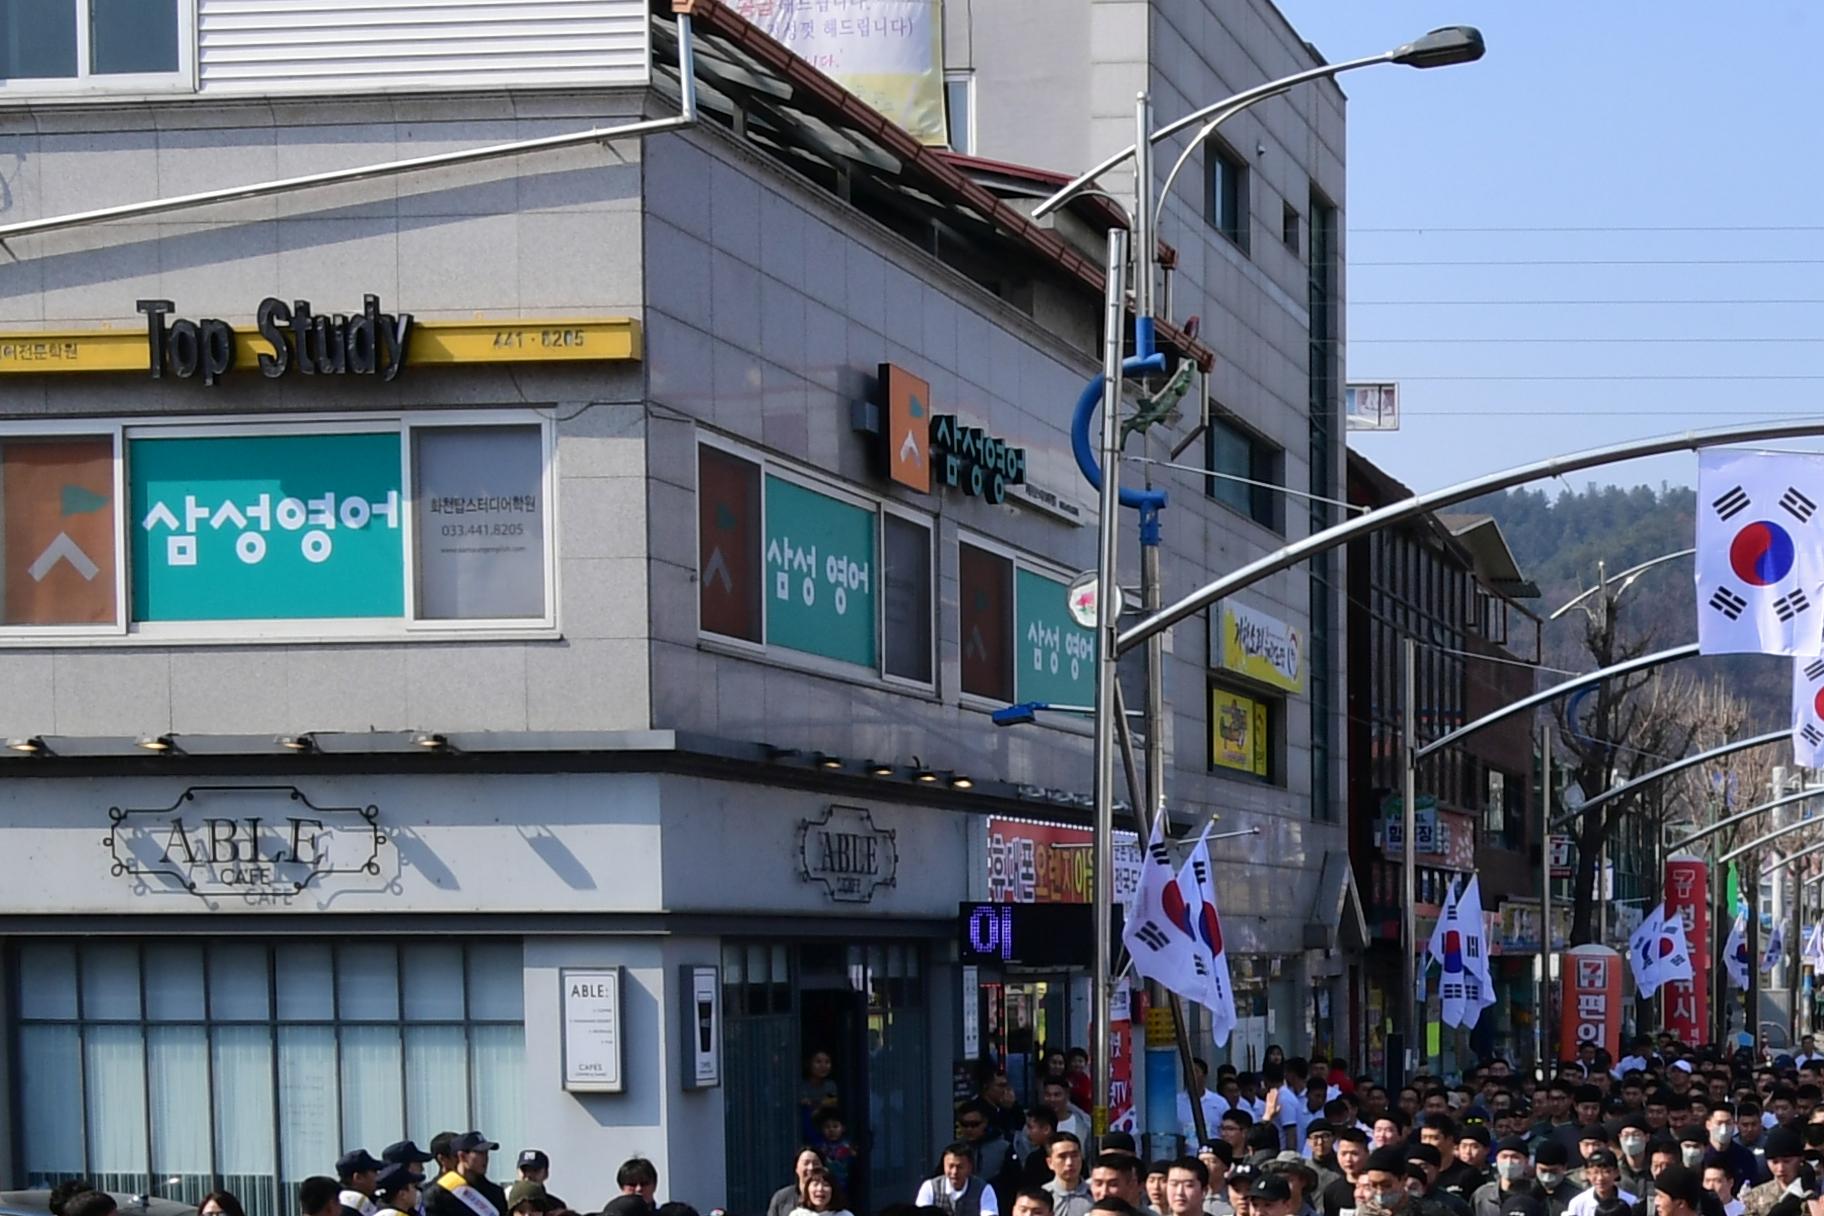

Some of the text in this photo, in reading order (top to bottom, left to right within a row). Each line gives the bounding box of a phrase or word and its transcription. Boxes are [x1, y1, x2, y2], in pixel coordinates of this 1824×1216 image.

[136, 293, 414, 387] Top Study
[937, 416, 1026, 504] 삼성영어
[143, 489, 399, 566] 삼성영어
[430, 496, 536, 514] 화천탑스터디어학원
[441, 524, 524, 536] 033.441.8205
[767, 536, 869, 614] 삼성 영어
[1027, 621, 1094, 681] 삼성 영어
[159, 816, 323, 864] ABLE
[814, 831, 878, 875] ABLE
[220, 867, 271, 886] CAFE
